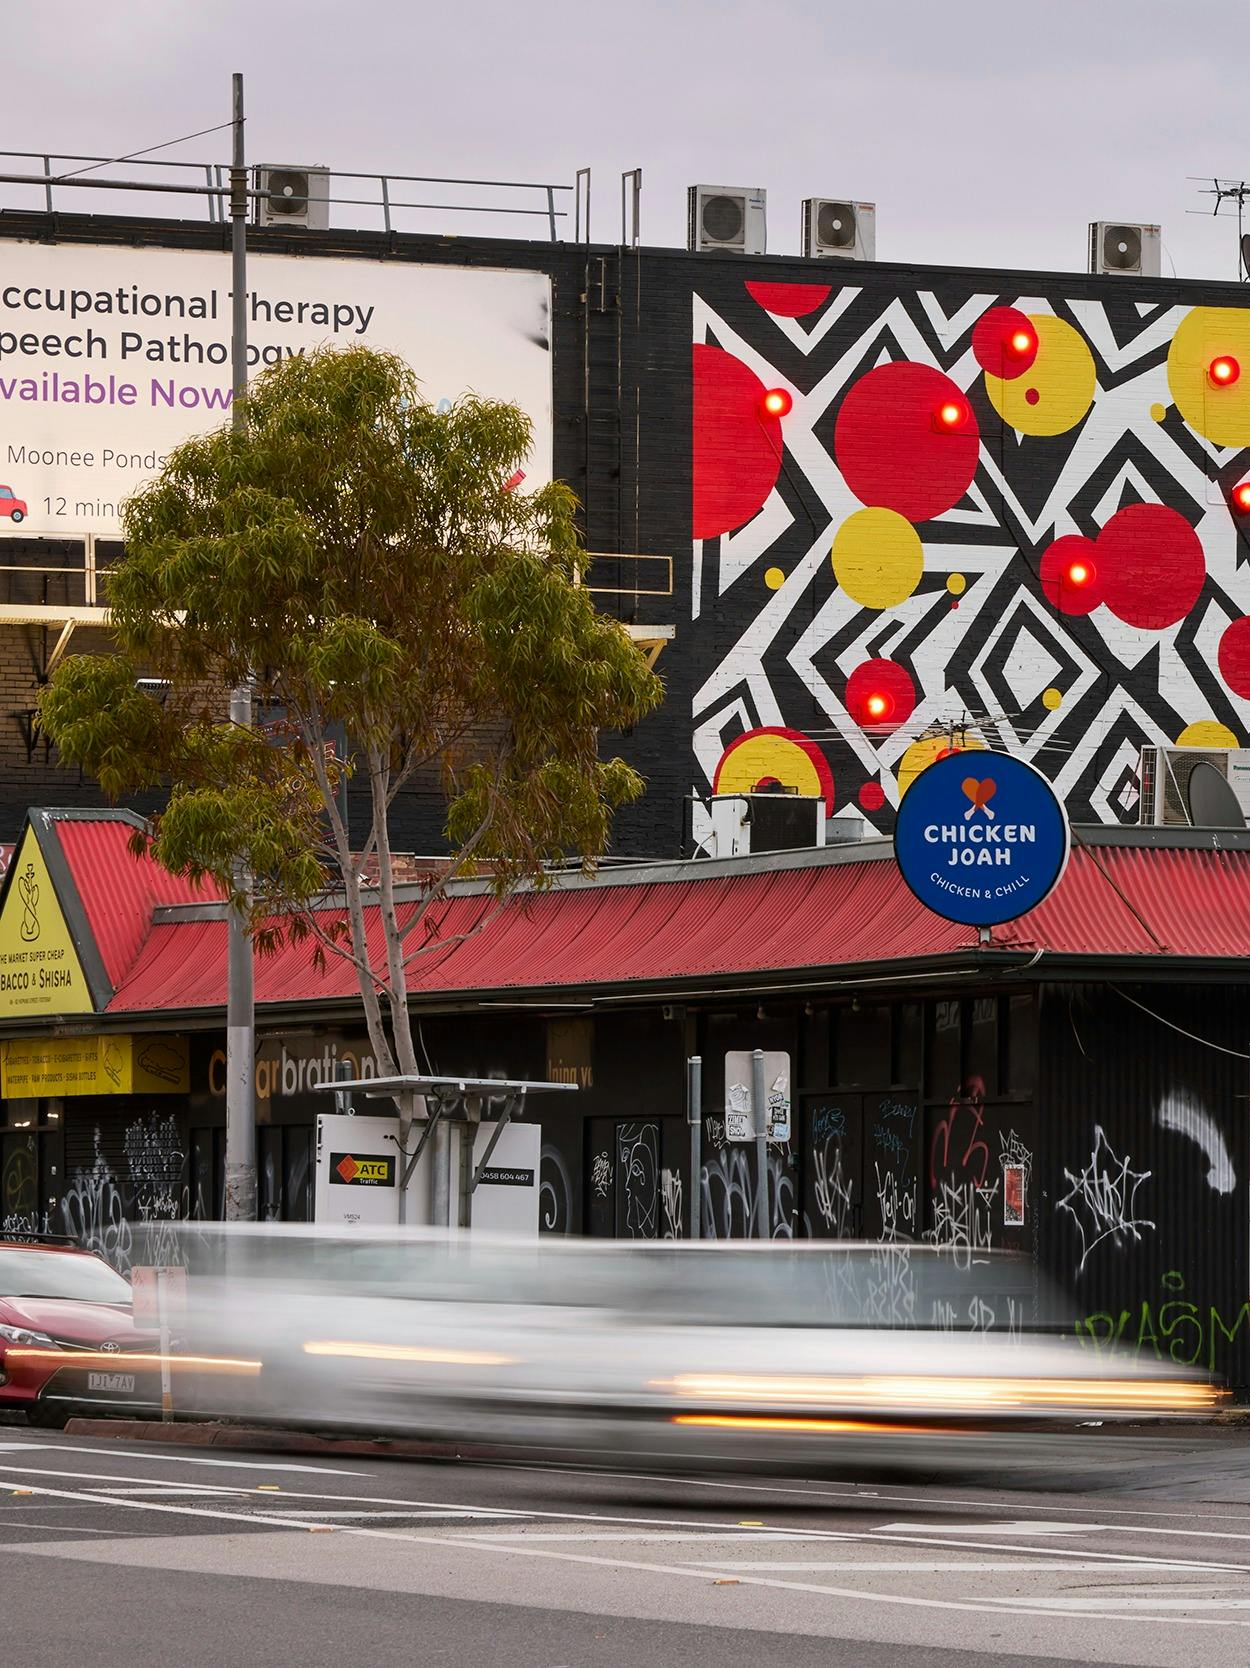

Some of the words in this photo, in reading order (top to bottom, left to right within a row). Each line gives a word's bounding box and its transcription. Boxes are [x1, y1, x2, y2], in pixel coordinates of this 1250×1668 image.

[228, 291, 375, 334] herapy
[7, 445, 94, 467] Moonee
[103, 449, 168, 470] Ponds
[43, 496, 68, 516] 12
[924, 824, 1036, 843] CHICKEN
[948, 848, 1011, 866] JOAH
[930, 872, 981, 898] CHICKEN
[984, 889, 992, 899] &
[995, 875, 1030, 897] CHILL
[29, 950, 46, 962] SUPER
[47, 949, 65, 960] CHEAP
[360, 1164, 386, 1176] ATC
